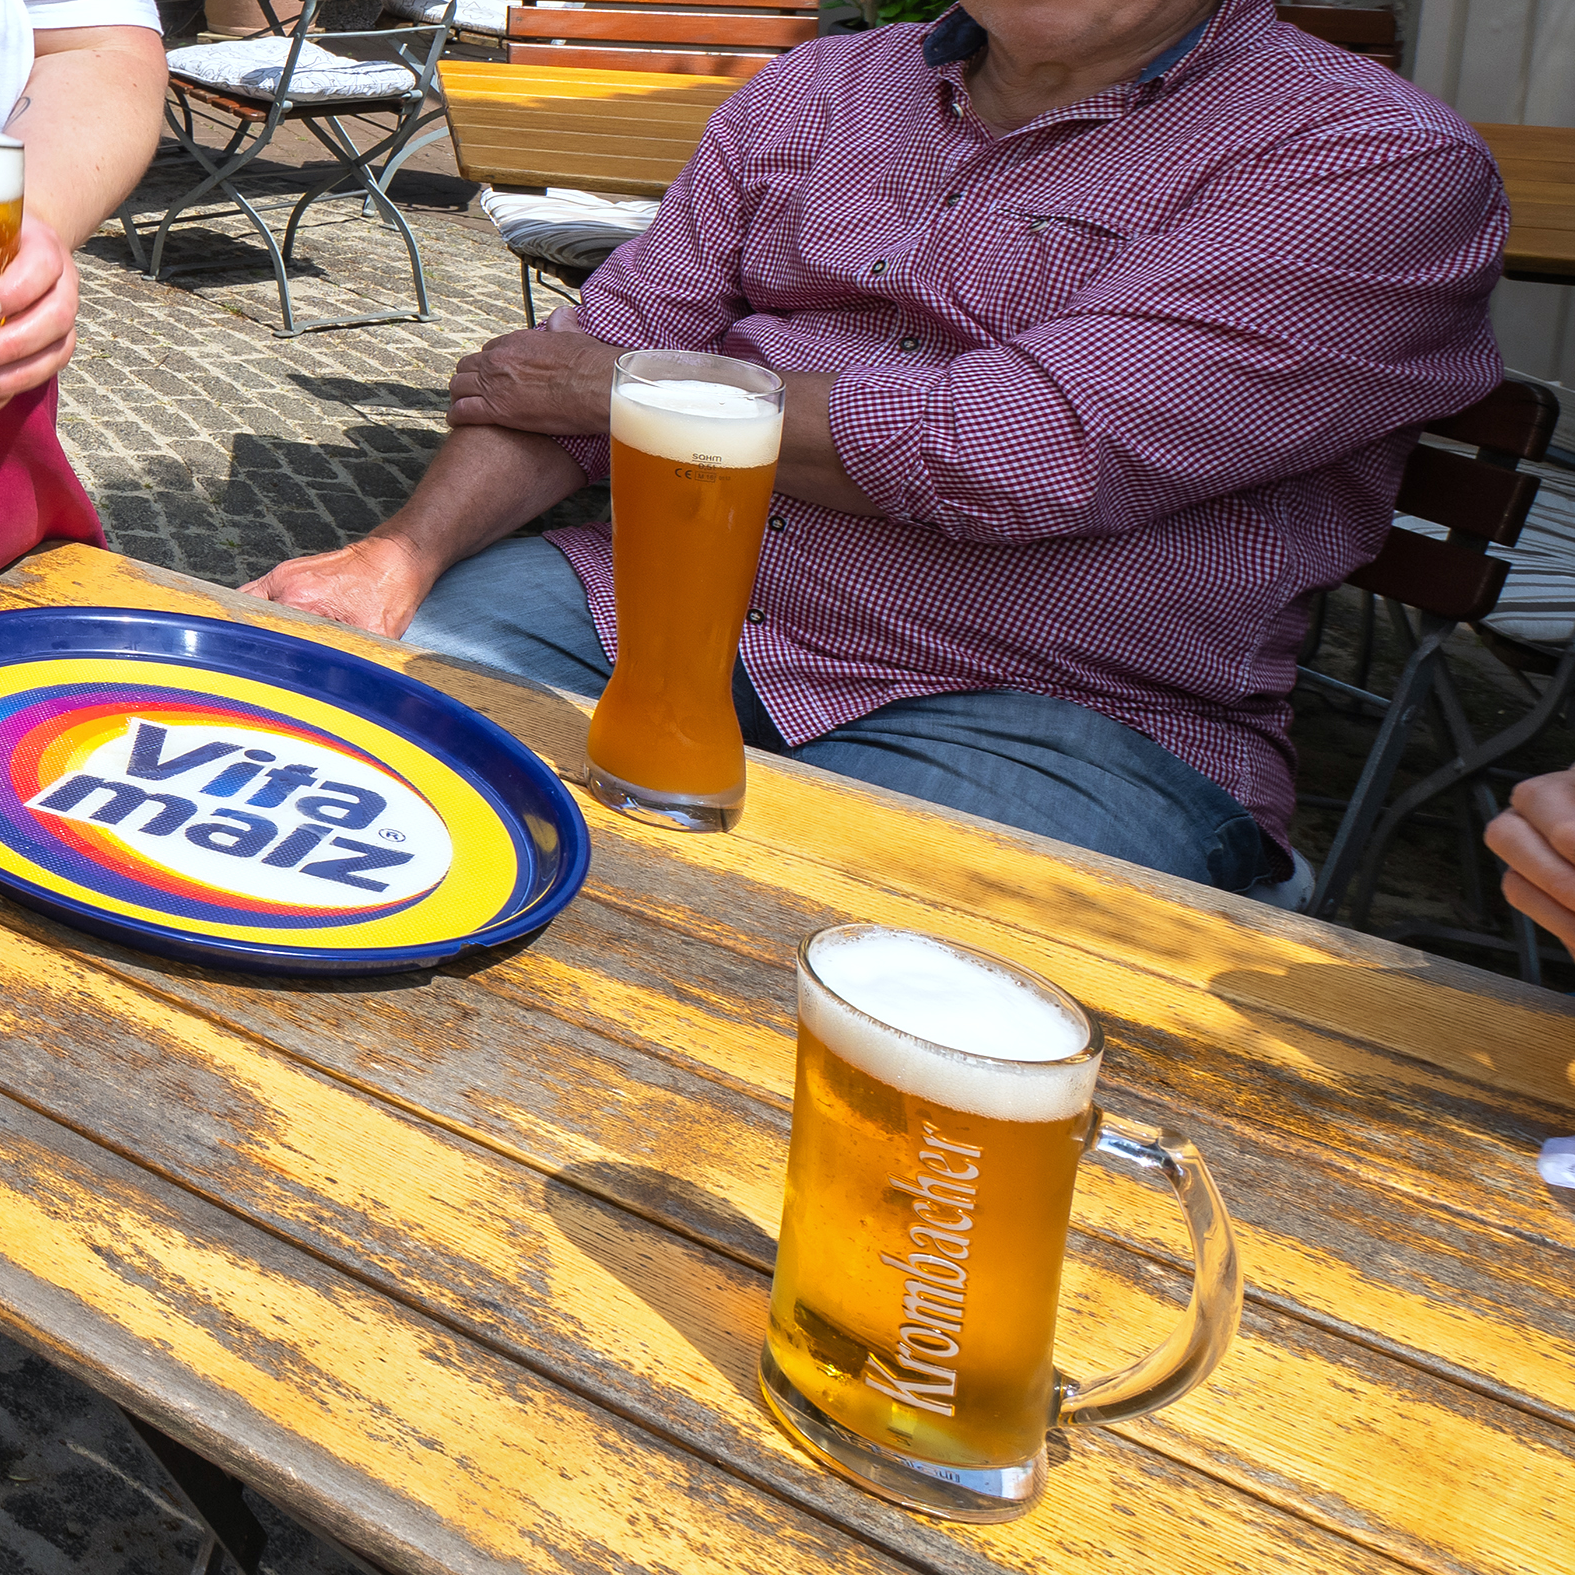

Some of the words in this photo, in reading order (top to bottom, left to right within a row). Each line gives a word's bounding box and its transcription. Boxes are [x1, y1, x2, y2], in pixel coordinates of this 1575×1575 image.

[38, 772, 414, 893] malz
[125, 718, 387, 830] Vita
[865, 1120, 985, 1417] Krombacher
